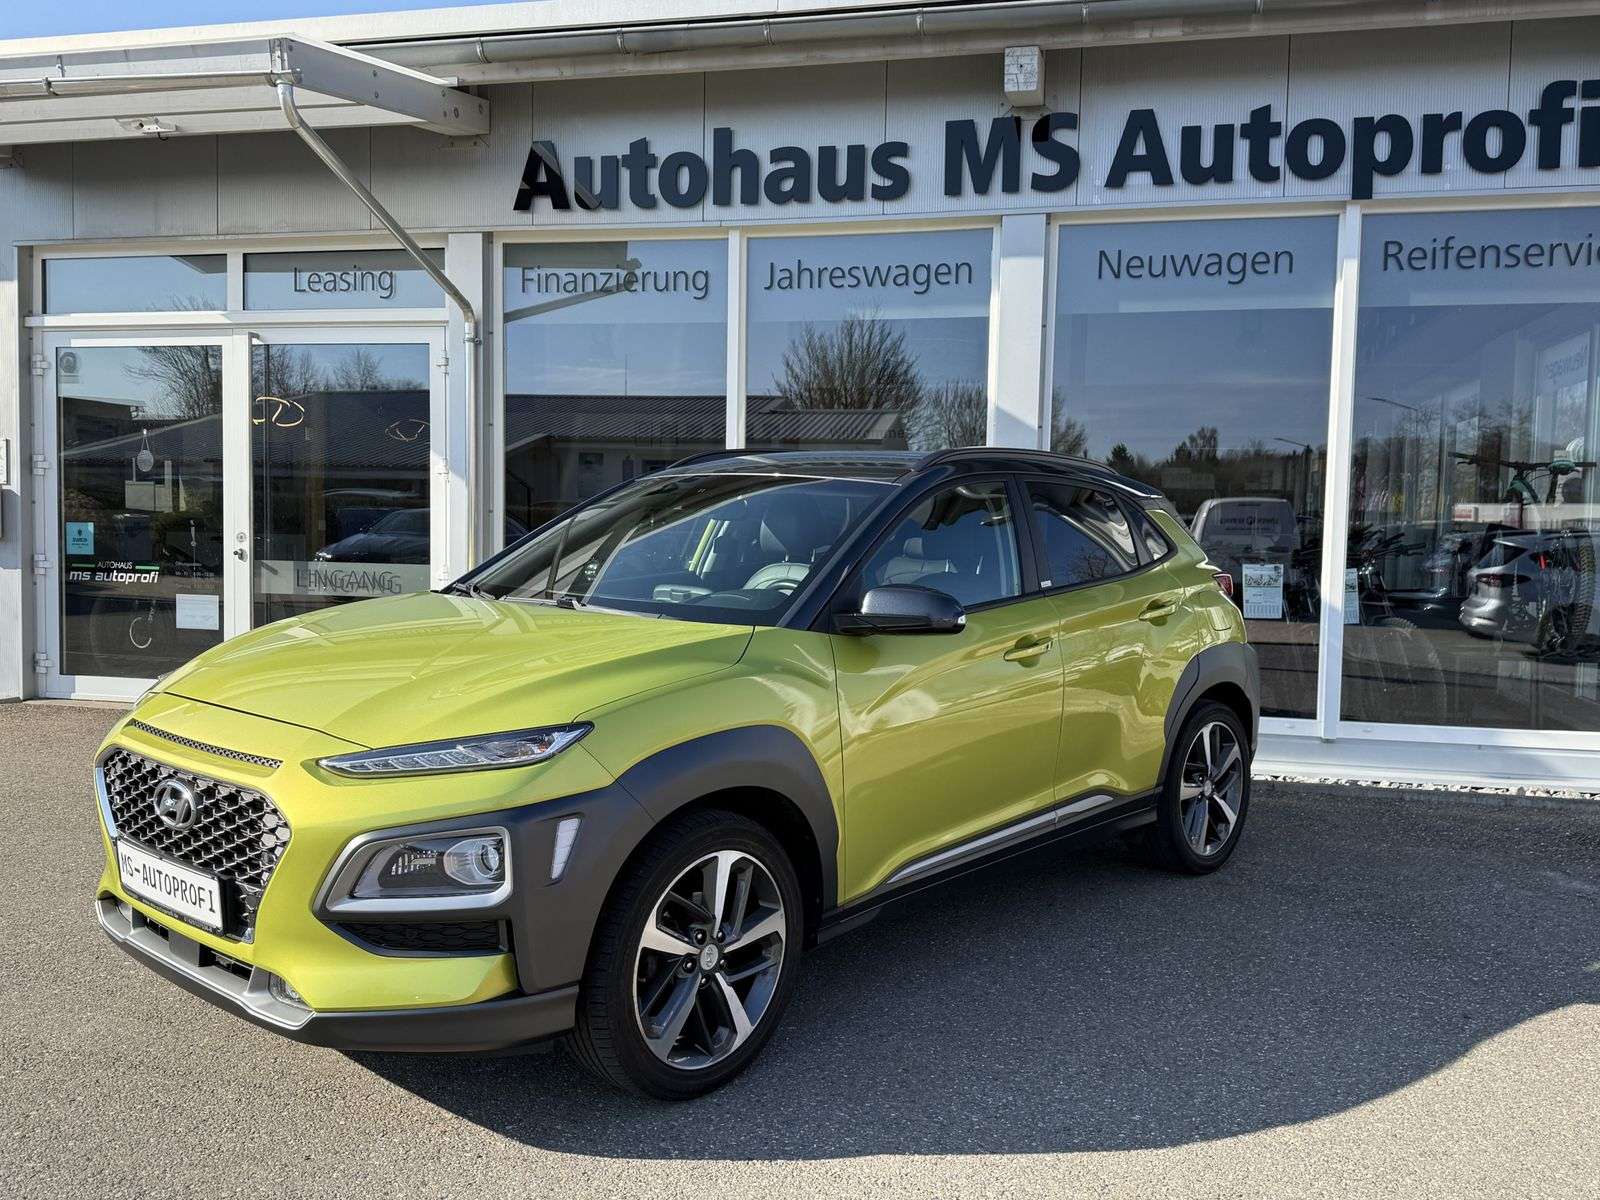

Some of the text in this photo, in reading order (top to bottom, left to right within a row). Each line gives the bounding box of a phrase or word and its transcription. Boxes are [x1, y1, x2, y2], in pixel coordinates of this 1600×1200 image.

[513, 79, 1600, 211] Autohaus MS Autoprofi
[1097, 247, 1295, 285] Neuwagen
[1383, 233, 1600, 272] Reifenservi
[293, 264, 396, 300] Leasing
[521, 264, 710, 300] Finanzierung
[764, 258, 973, 293] Jahreswagen
[69, 570, 159, 584] ms autoprofi
[97, 561, 133, 570] AUTOHAUS
[296, 569, 399, 592] EINGANG
